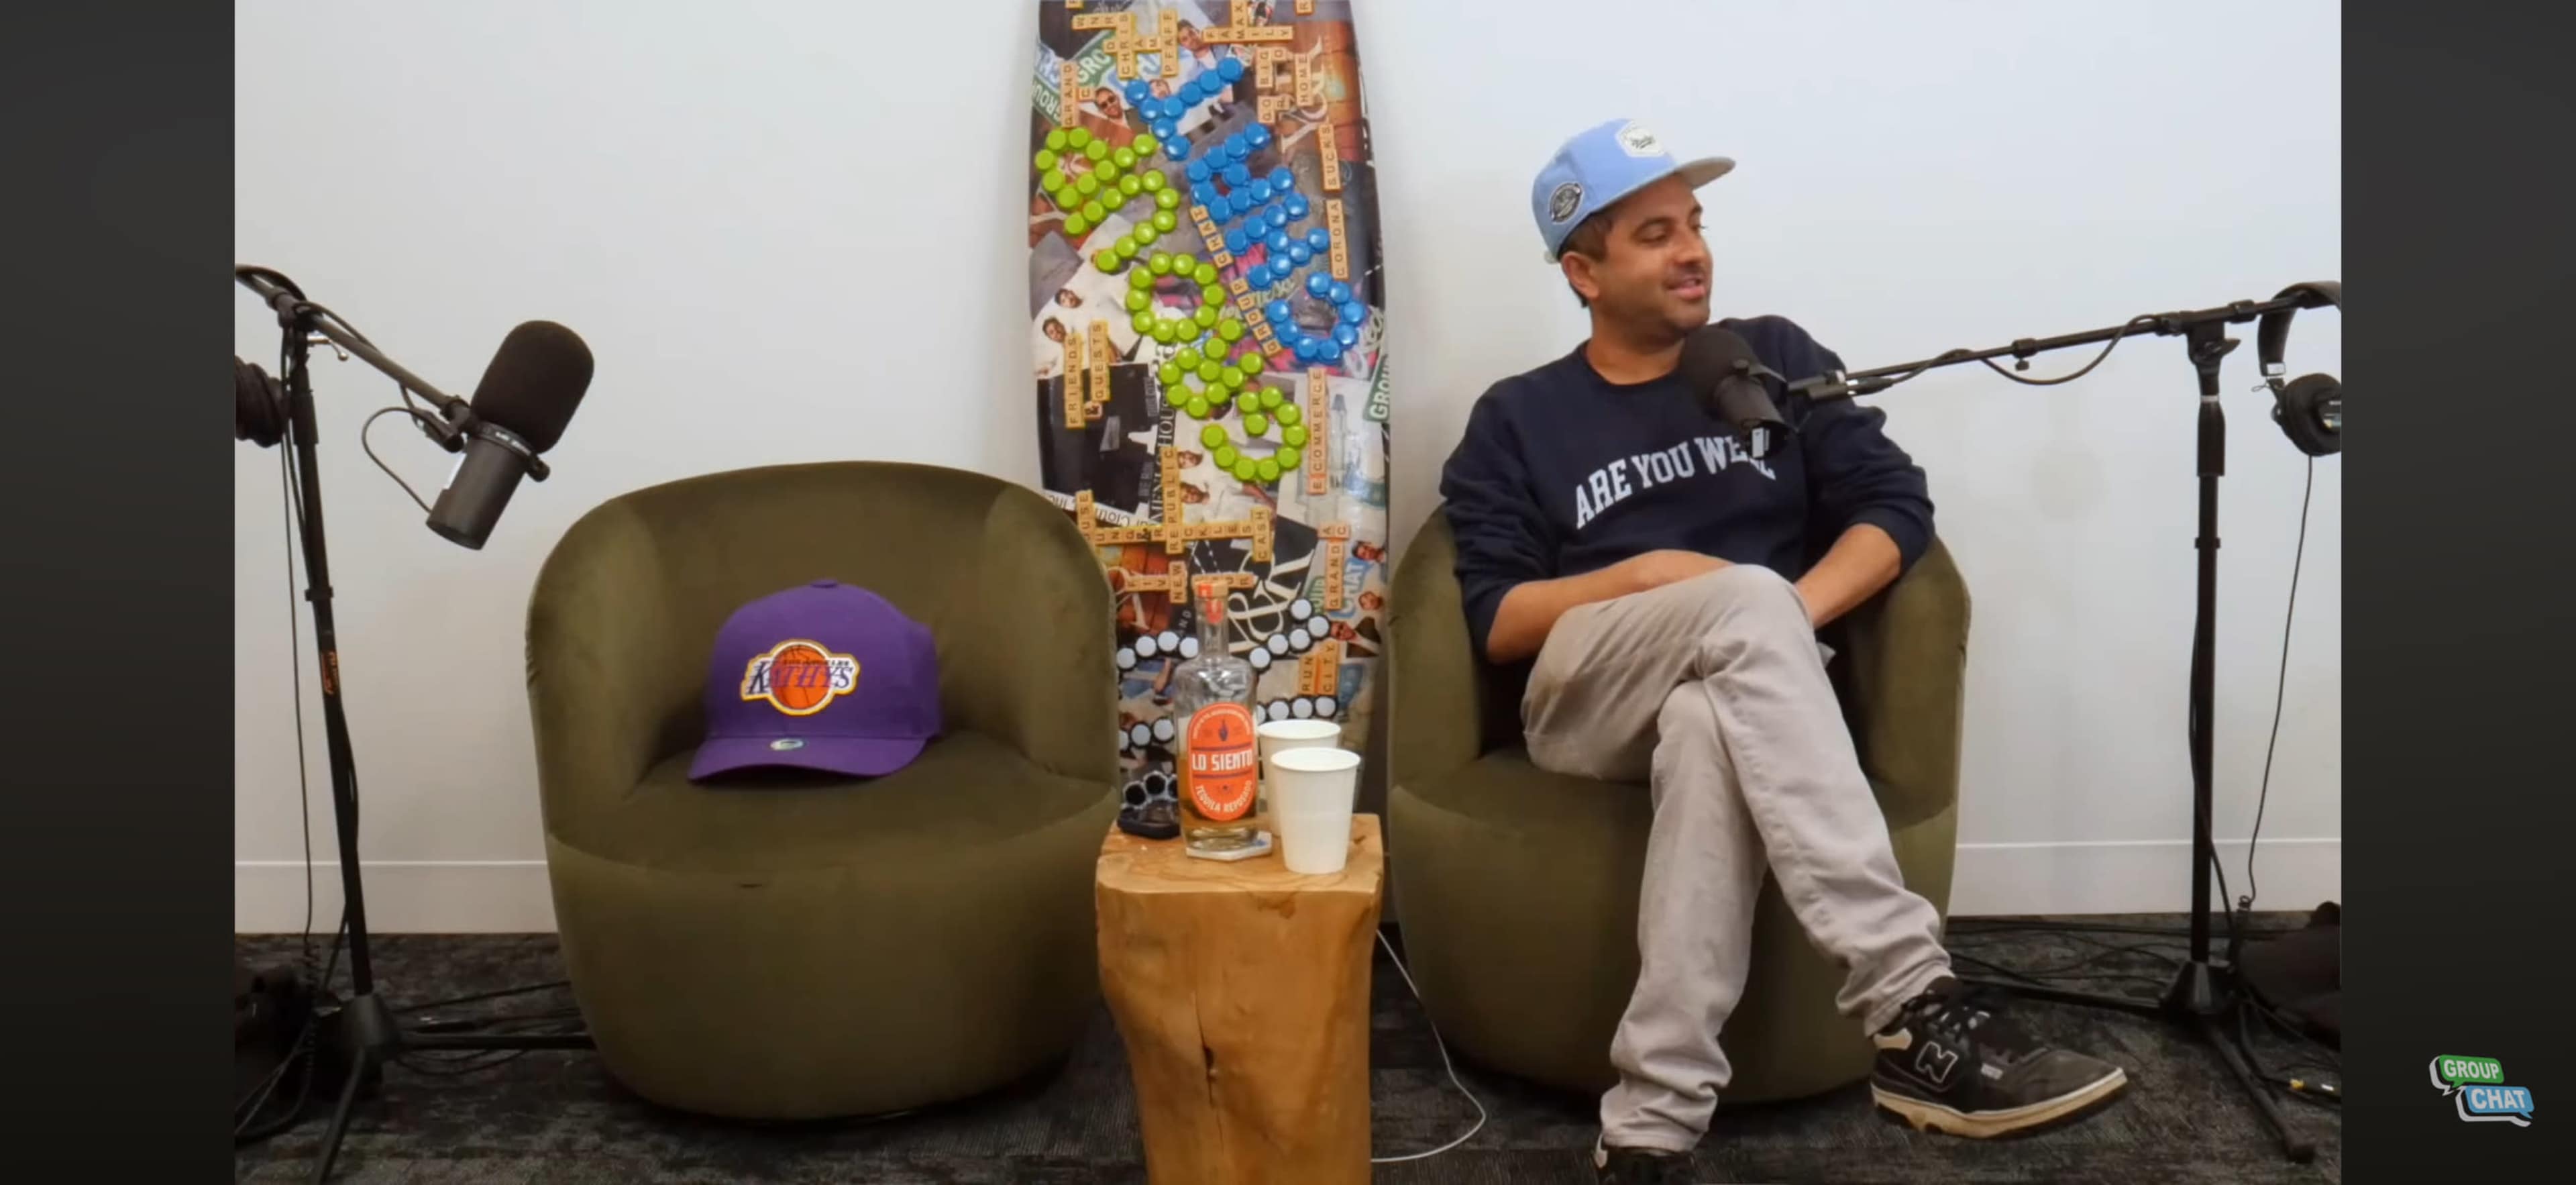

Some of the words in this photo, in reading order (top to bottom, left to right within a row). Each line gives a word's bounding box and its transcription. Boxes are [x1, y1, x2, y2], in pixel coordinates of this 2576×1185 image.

[1119, 13, 1131, 74] CHRIS
[1163, 12, 1174, 72] PFAFF
[1206, 29, 1289, 40] FAMILY
[1063, 65, 1075, 125] GRAND
[1259, 51, 1269, 85] BIG
[1298, 56, 1309, 104] HOME
[1324, 126, 1338, 187] SUCKS
[1329, 202, 1346, 276] CORONA
[1067, 336, 1079, 425] FRIENDS
[1093, 323, 1105, 399] GUESTS
[1164, 450, 1179, 550] REPUBLIC
[1575, 458, 1633, 530] ARE
[1631, 441, 1696, 489] YOU
[1693, 434, 1776, 481] WE
[1255, 510, 1268, 560] CASH
[1330, 545, 1342, 607] GRAND
[1302, 656, 1314, 691] RUN
[1323, 642, 1336, 692] CITY
[1192, 753, 1207, 772] LO
[1211, 748, 1252, 772] SIENTO
